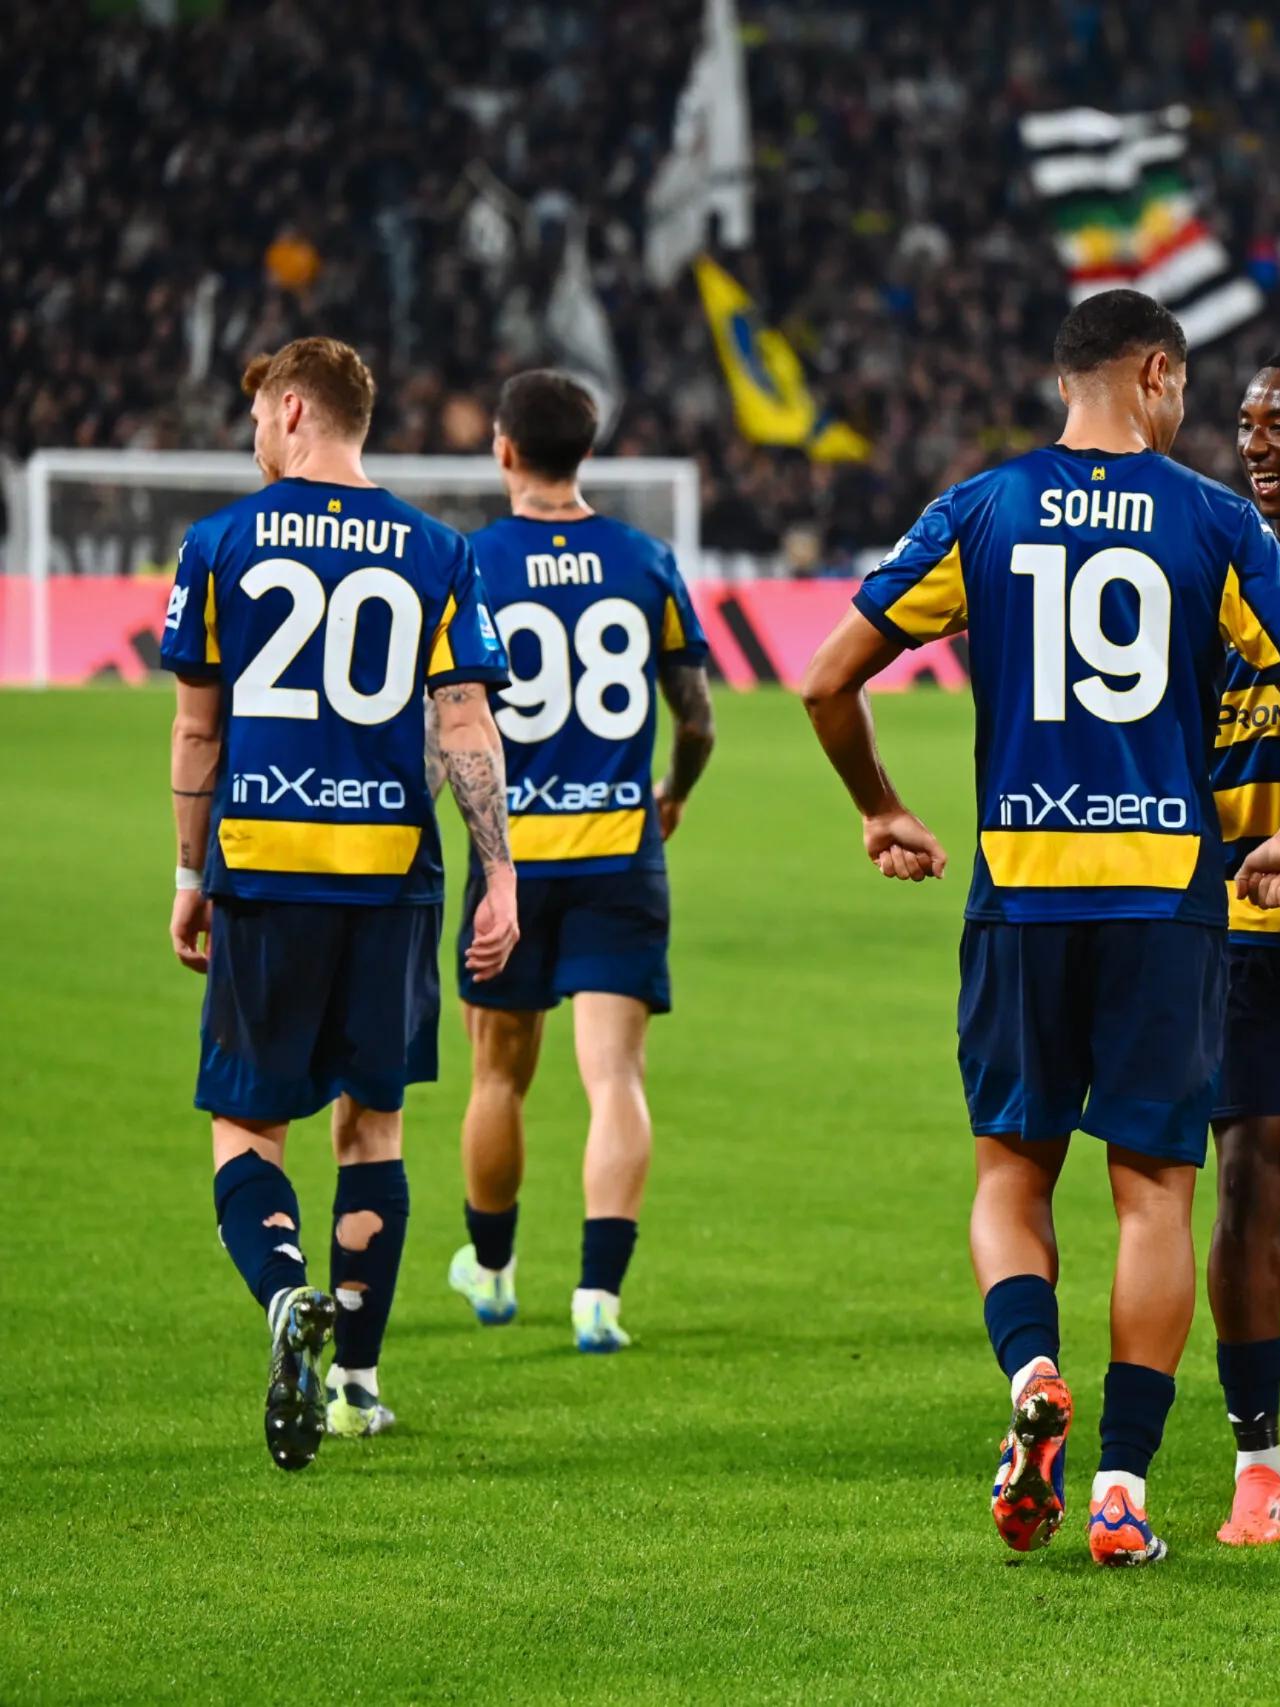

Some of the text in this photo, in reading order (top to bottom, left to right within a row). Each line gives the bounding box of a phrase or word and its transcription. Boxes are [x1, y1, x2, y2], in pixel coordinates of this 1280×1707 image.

[1040, 488, 1154, 533] SOHM
[256, 511, 412, 559] HAINAUT
[525, 552, 603, 588] MAN
[232, 558, 424, 725] 20
[1010, 543, 1172, 723] 19
[491, 597, 651, 744] 98
[1000, 783, 1187, 828] inX.aero
